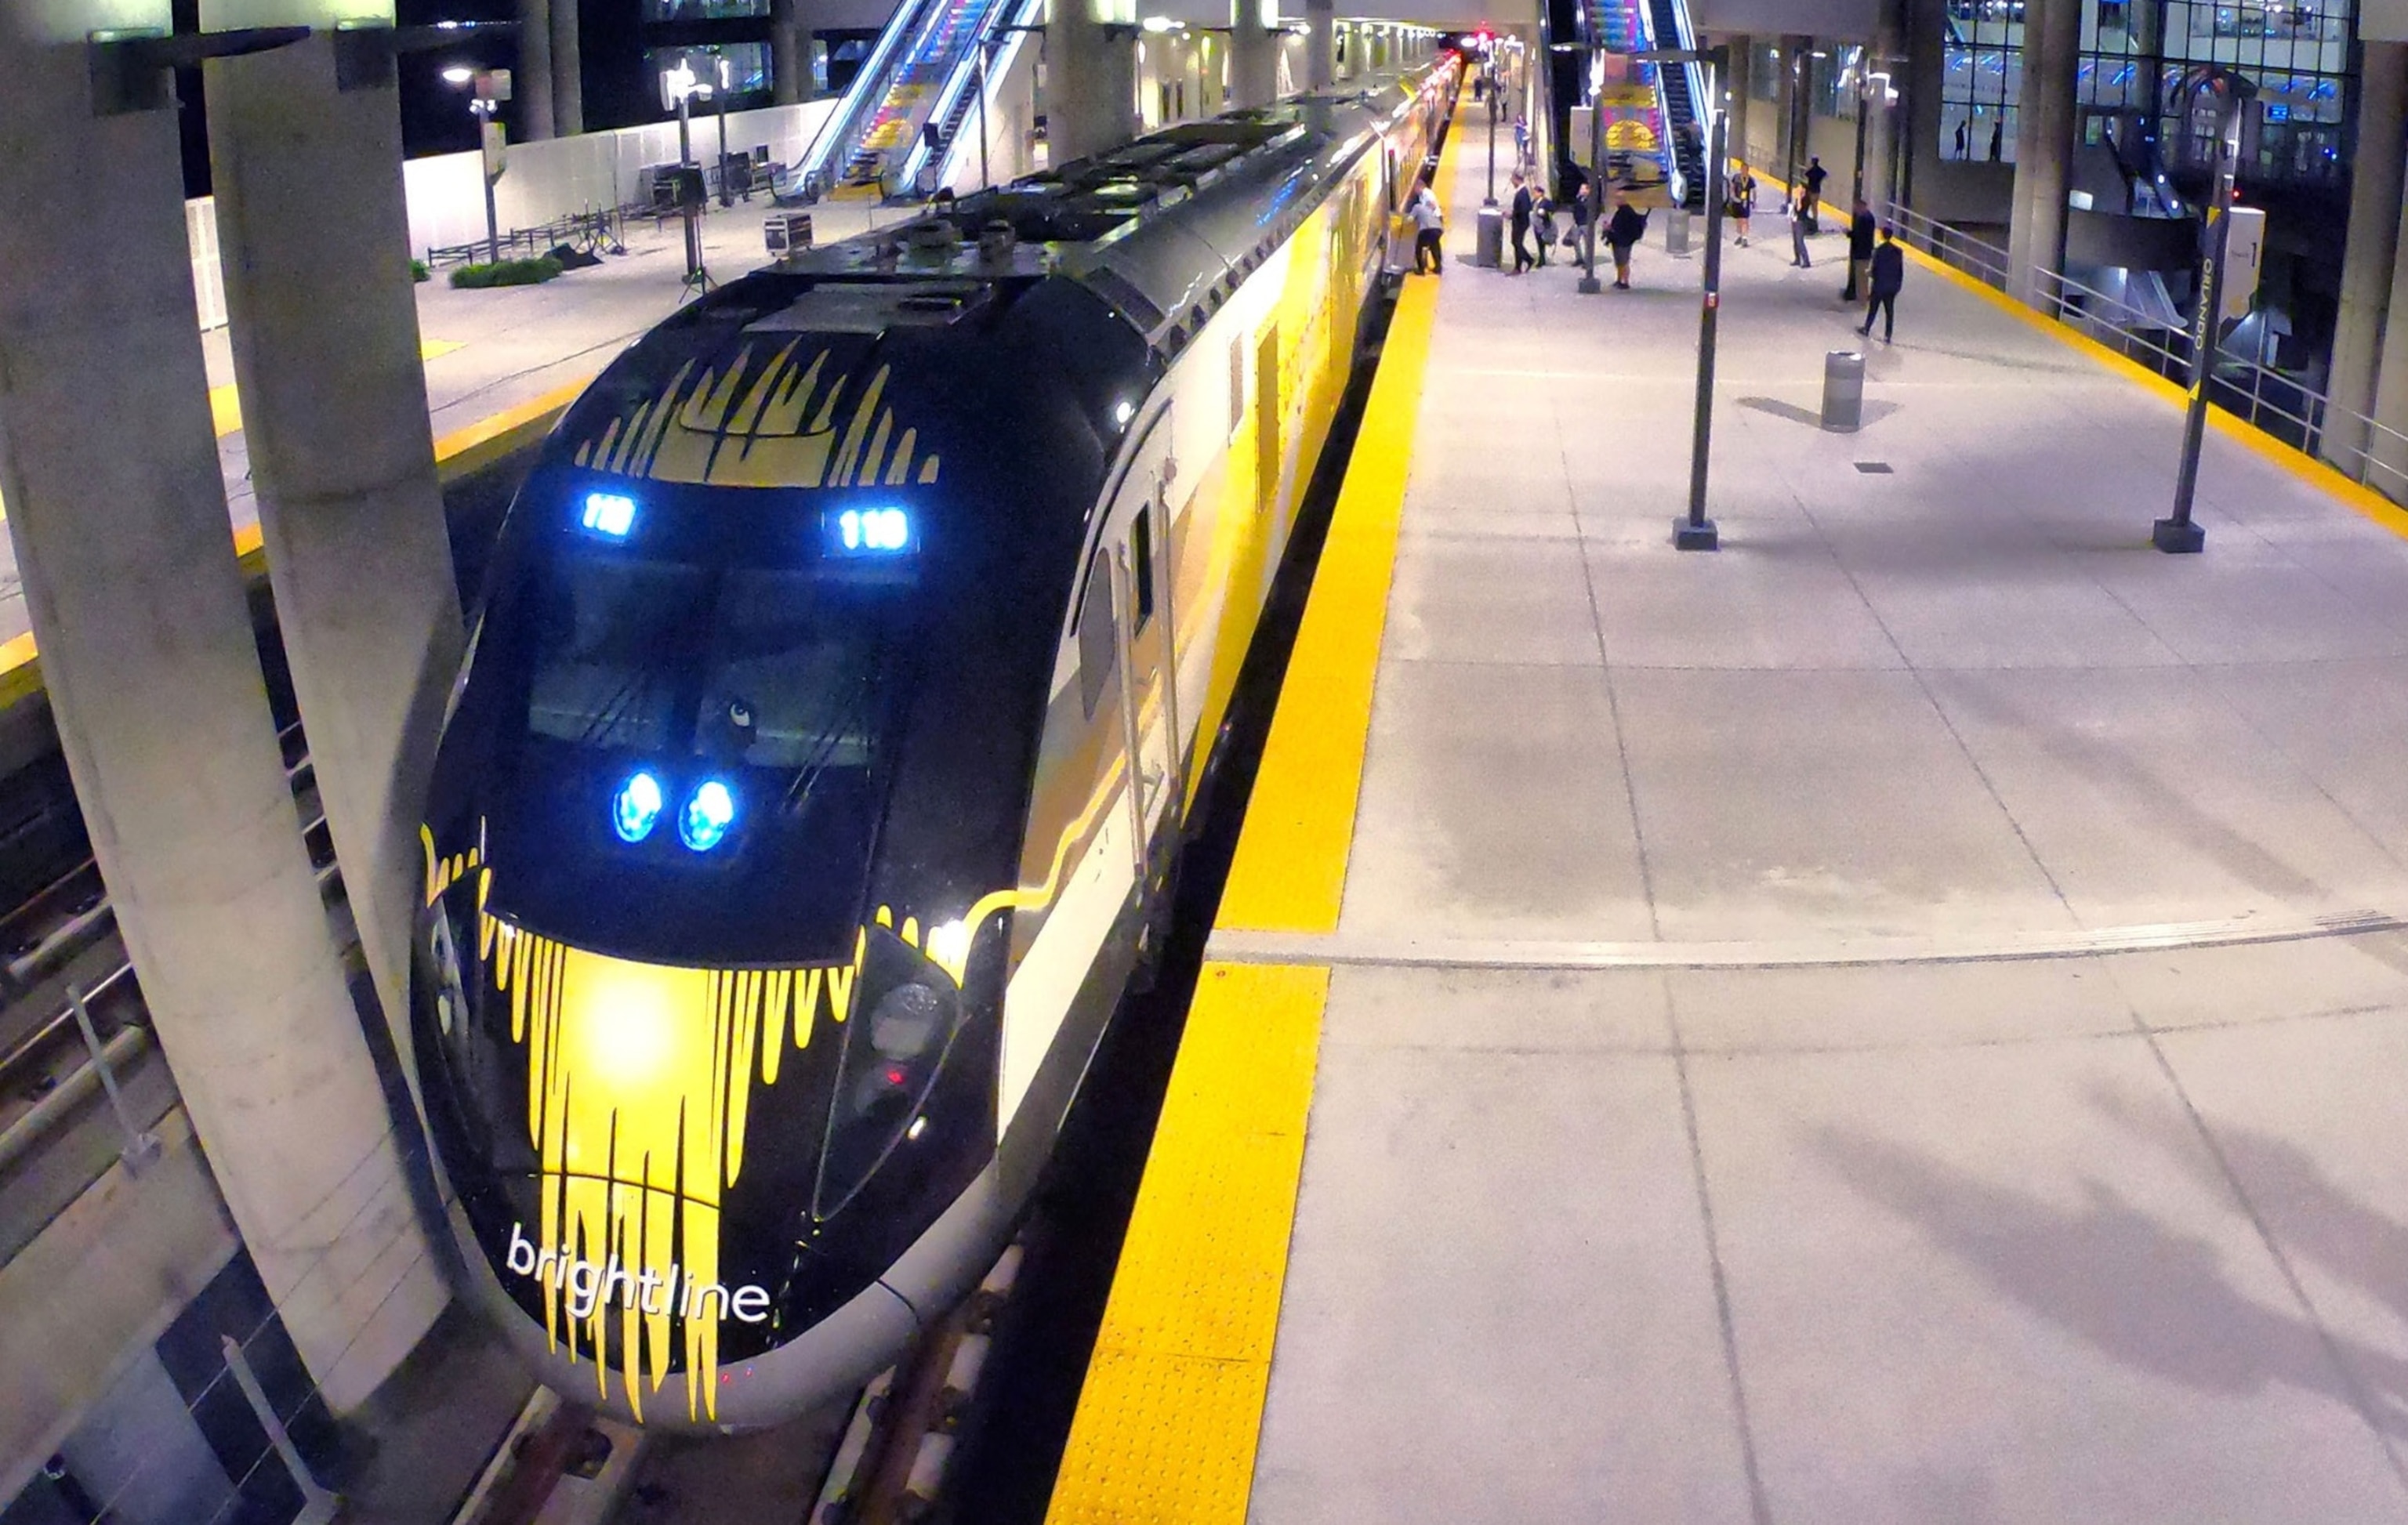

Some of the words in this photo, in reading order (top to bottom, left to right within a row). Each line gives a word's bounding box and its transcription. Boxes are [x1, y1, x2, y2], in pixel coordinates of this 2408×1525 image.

[2251, 242, 2257, 267] 1
[2195, 258, 2212, 350] ORLANDO
[507, 1223, 770, 1321] brightline
